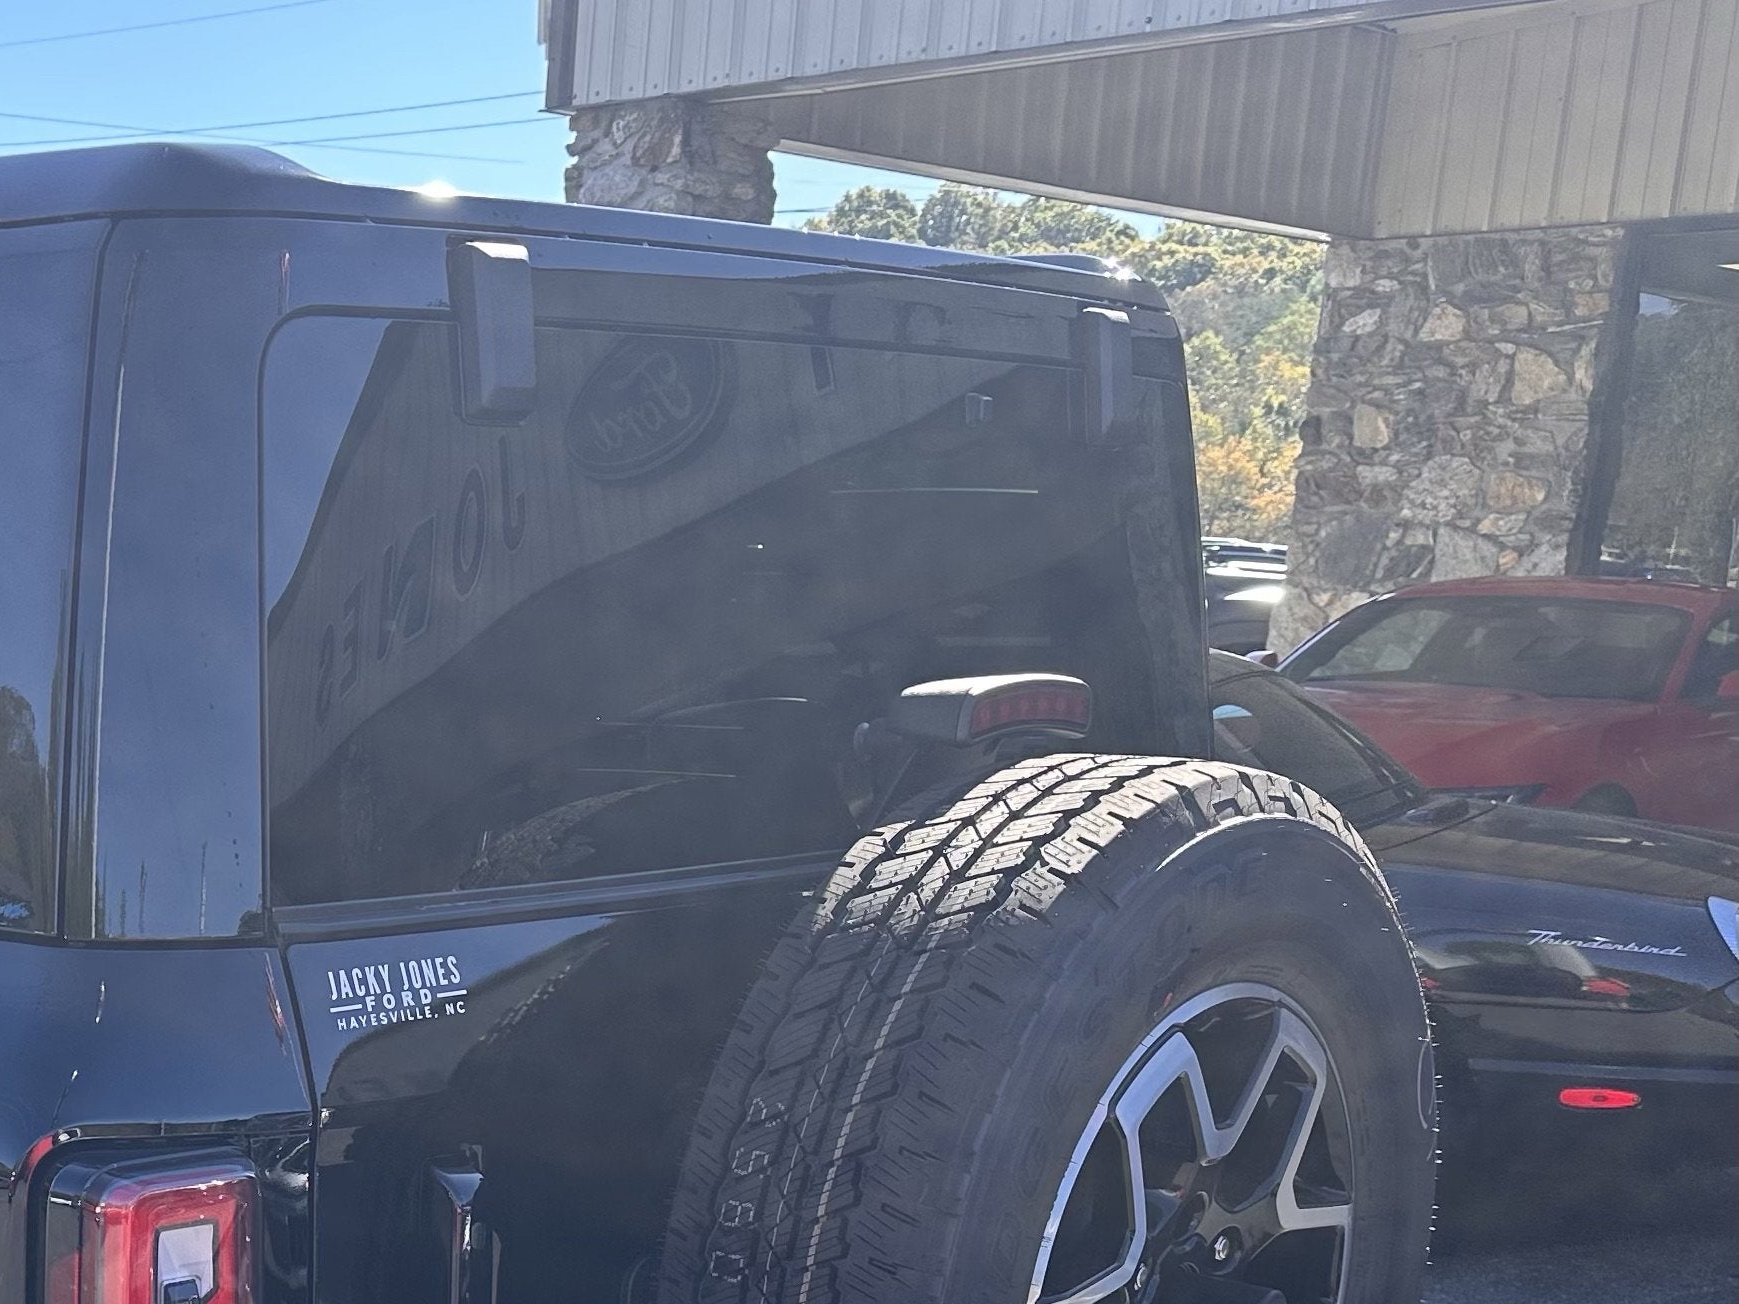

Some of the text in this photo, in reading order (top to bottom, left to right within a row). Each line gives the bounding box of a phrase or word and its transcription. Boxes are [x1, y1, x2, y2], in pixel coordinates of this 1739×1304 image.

[1527, 929, 1687, 957] Thunderbird
[327, 955, 462, 1001] JACKY JONES
[365, 988, 433, 1012] FORD
[336, 1001, 466, 1031] HAYESVILLE, NC
